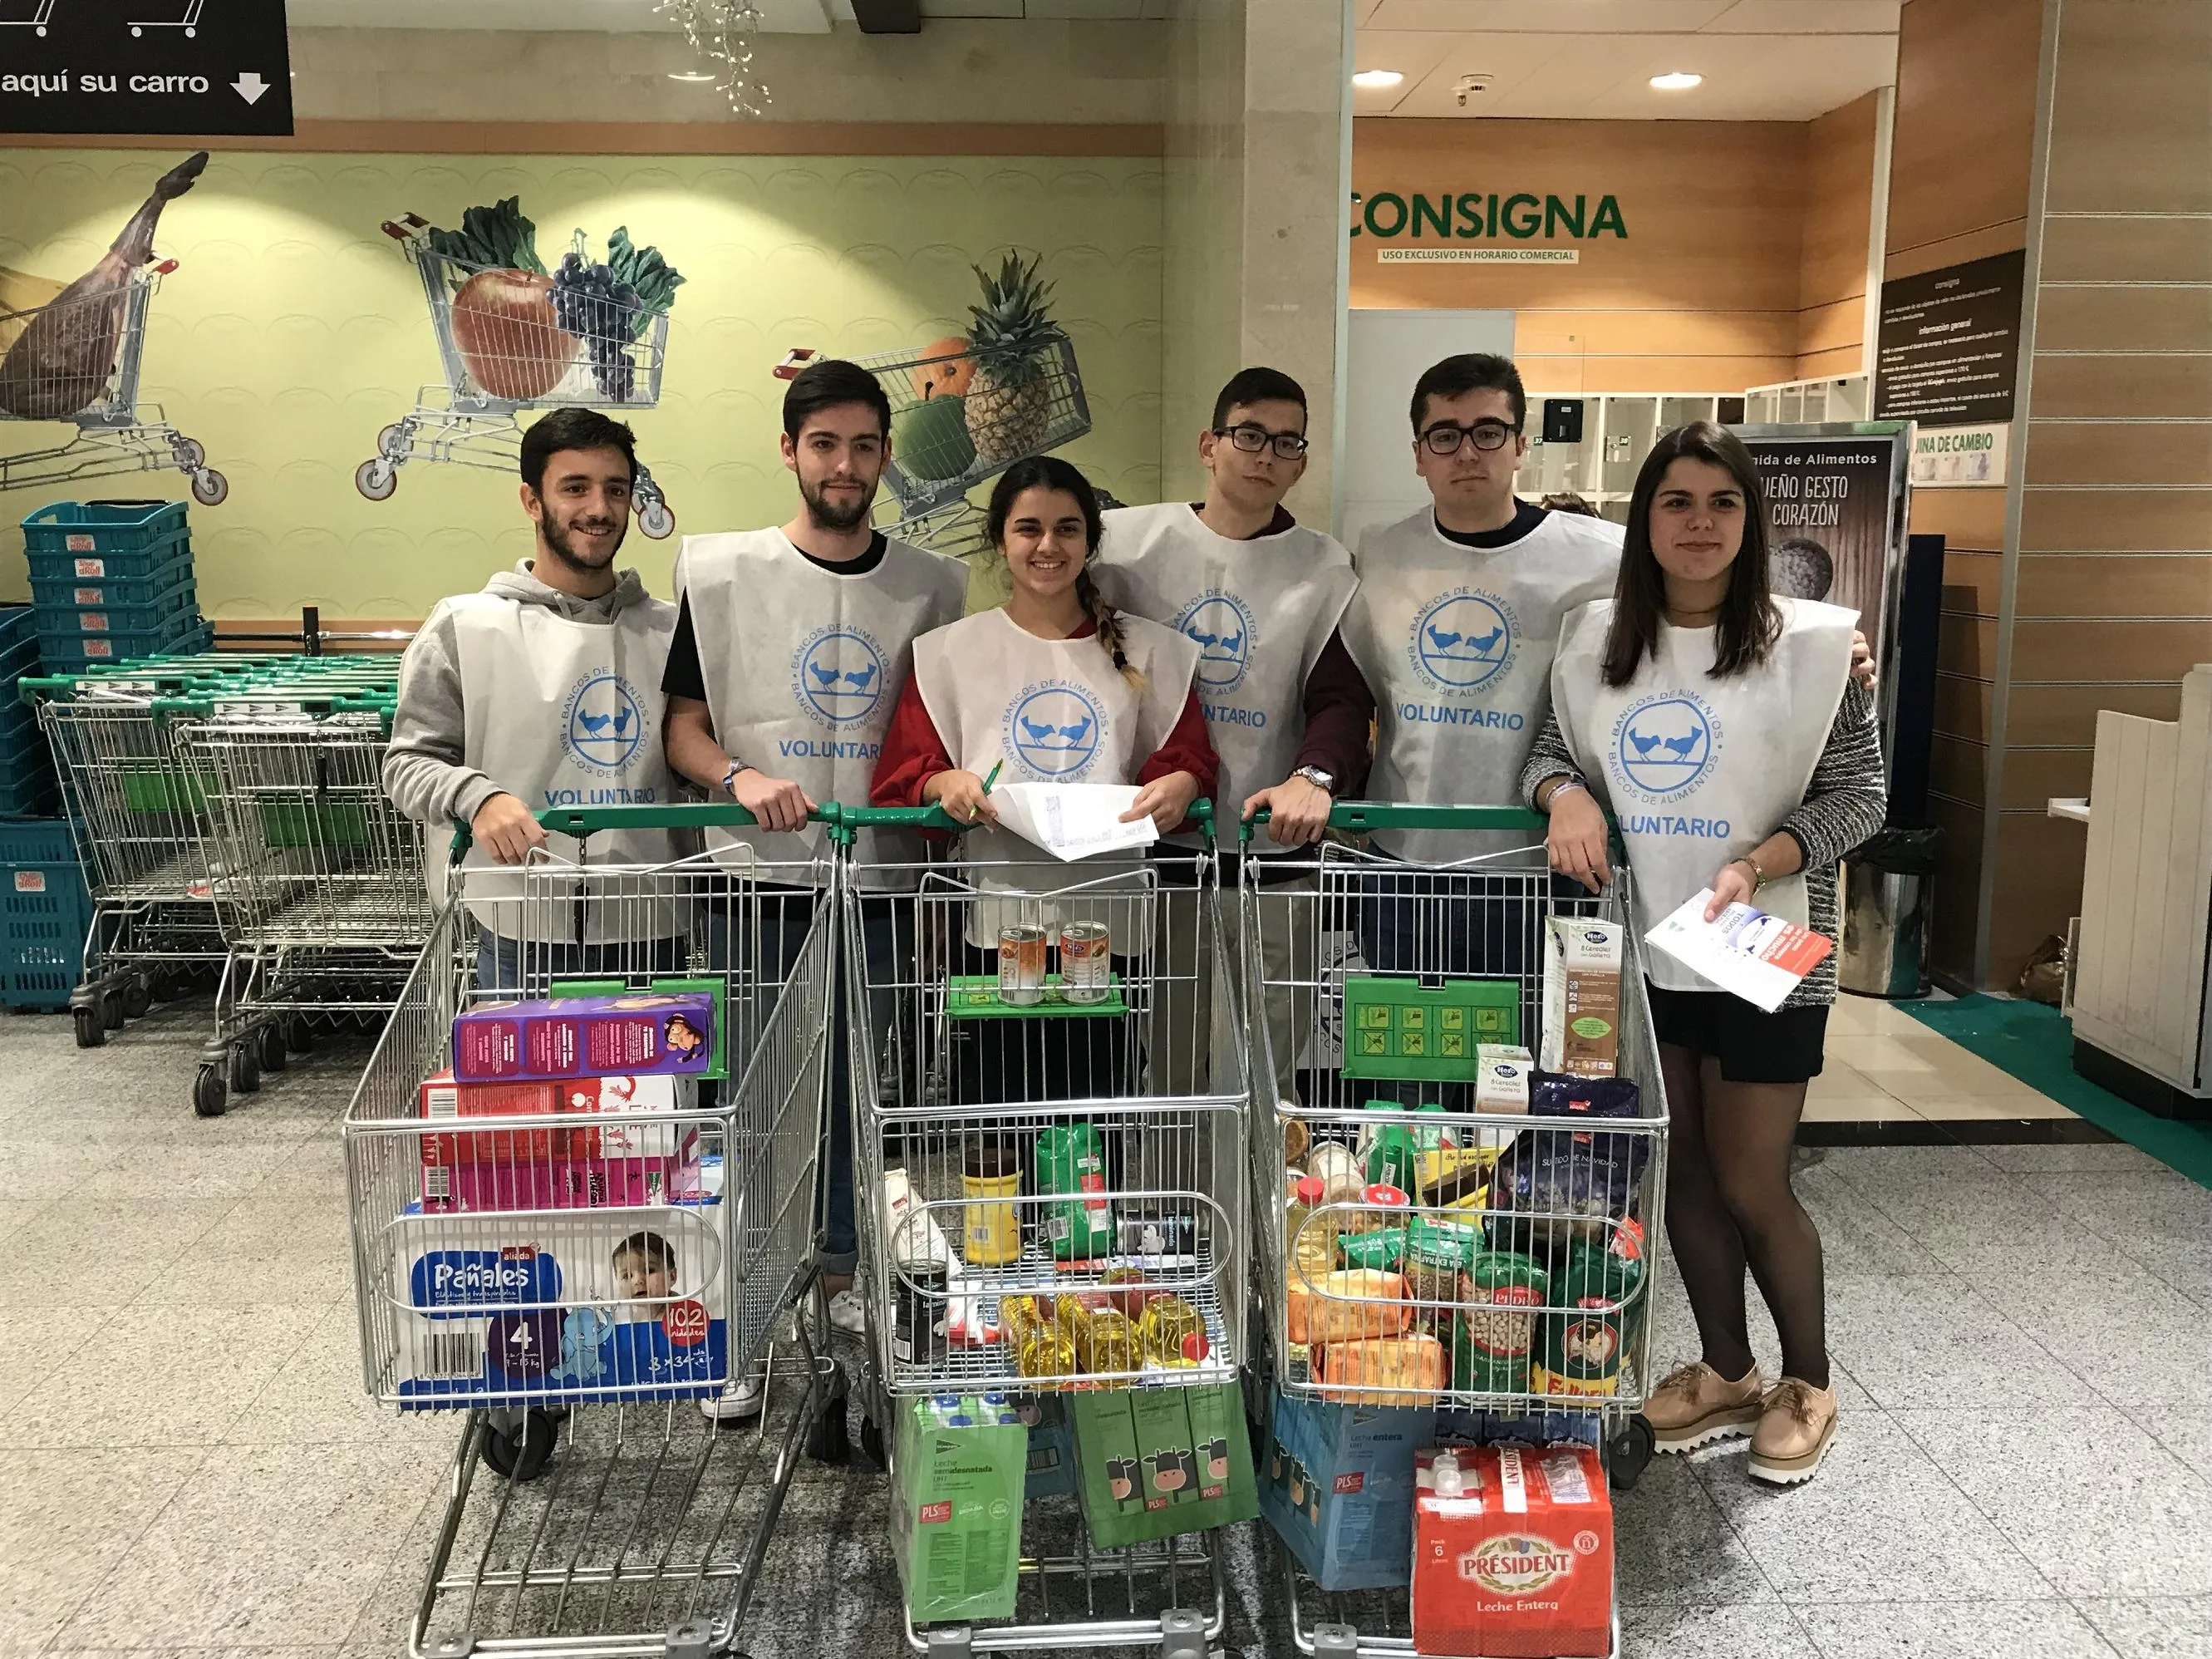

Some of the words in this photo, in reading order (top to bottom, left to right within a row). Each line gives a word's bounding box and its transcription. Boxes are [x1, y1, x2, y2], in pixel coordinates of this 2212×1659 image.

[2, 69, 68, 97] aquí
[80, 75, 117, 92] su
[129, 74, 209, 93] carro
[1382, 250, 1403, 259] USO
[1404, 250, 1457, 259] EXCLUSIVO
[1458, 251, 1472, 259] EN
[1474, 251, 1518, 260] HORARIO
[1520, 251, 1575, 260] COMERCIAL
[1938, 436, 1950, 452] DE
[1952, 432, 1993, 452] CAMBIO
[1785, 455, 1801, 465] de
[1806, 454, 1877, 465] Alimentos
[1805, 475, 1848, 499] GESTO
[1772, 500, 1839, 525] CORAZÓN
[1206, 588, 1221, 597] DE
[1223, 589, 1258, 642] ALIMENTOS
[1409, 591, 1450, 632] BANCOS
[1454, 586, 1469, 595] DE
[1473, 588, 1521, 639] ALIMENTOS
[791, 627, 825, 670] BANCOS
[828, 623, 842, 632] DE
[846, 624, 892, 675] ALIMENTOS
[1408, 645, 1436, 690] BANCOS
[1438, 687, 1455, 697] DE
[1458, 653, 1516, 697] ALIMENTOS
[561, 672, 591, 719] BANCOS
[592, 666, 609, 677] DE
[1002, 684, 1037, 723] BANCOS
[1040, 679, 1055, 688] DE
[1059, 679, 1109, 727] ALIMENTOS
[791, 682, 824, 726] BANCOS
[827, 723, 838, 731] DE
[843, 689, 888, 732] ALIMENTOS
[1204, 705, 1266, 727] NTARIO
[1396, 702, 1524, 731] VOLUNTARIO
[1611, 695, 1655, 736] BANCOS
[1659, 690, 1676, 700] DE
[1678, 688, 1723, 739] ALIMENTOS
[559, 732, 593, 774] BANCOS
[597, 769, 612, 779] DE
[779, 740, 882, 760] VOLUNTAR
[1002, 736, 1035, 780] BANCOS
[1056, 740, 1106, 784] ALIMENTOS
[1608, 751, 1638, 798] BANCOS
[1641, 795, 1656, 805] DE
[1660, 755, 1719, 805] ALIMENTOS
[544, 788, 656, 806] VOLUNTARIO
[1618, 815, 1731, 839] LUNTARIO
[1497, 1066, 1516, 1074] Hero
[1541, 1154, 1568, 1166] SUTIDO
[434, 1263, 529, 1289] Pañales
[670, 1307, 705, 1327] 102
[510, 1322, 533, 1350] 4
[671, 1328, 705, 1337] nidades
[1372, 1433, 1403, 1441] entera
[933, 1465, 993, 1474] semidesnatada
[1202, 1488, 1215, 1497] PLS
[1336, 1475, 1352, 1489] PLS
[922, 1504, 939, 1519] PLS
[1148, 1499, 1160, 1509] PLS
[1434, 1546, 1443, 1557] 6
[1463, 1553, 1569, 1578] PRÉSIDENT
[1477, 1600, 1513, 1612] Leche
[1516, 1599, 1559, 1611] Entera
